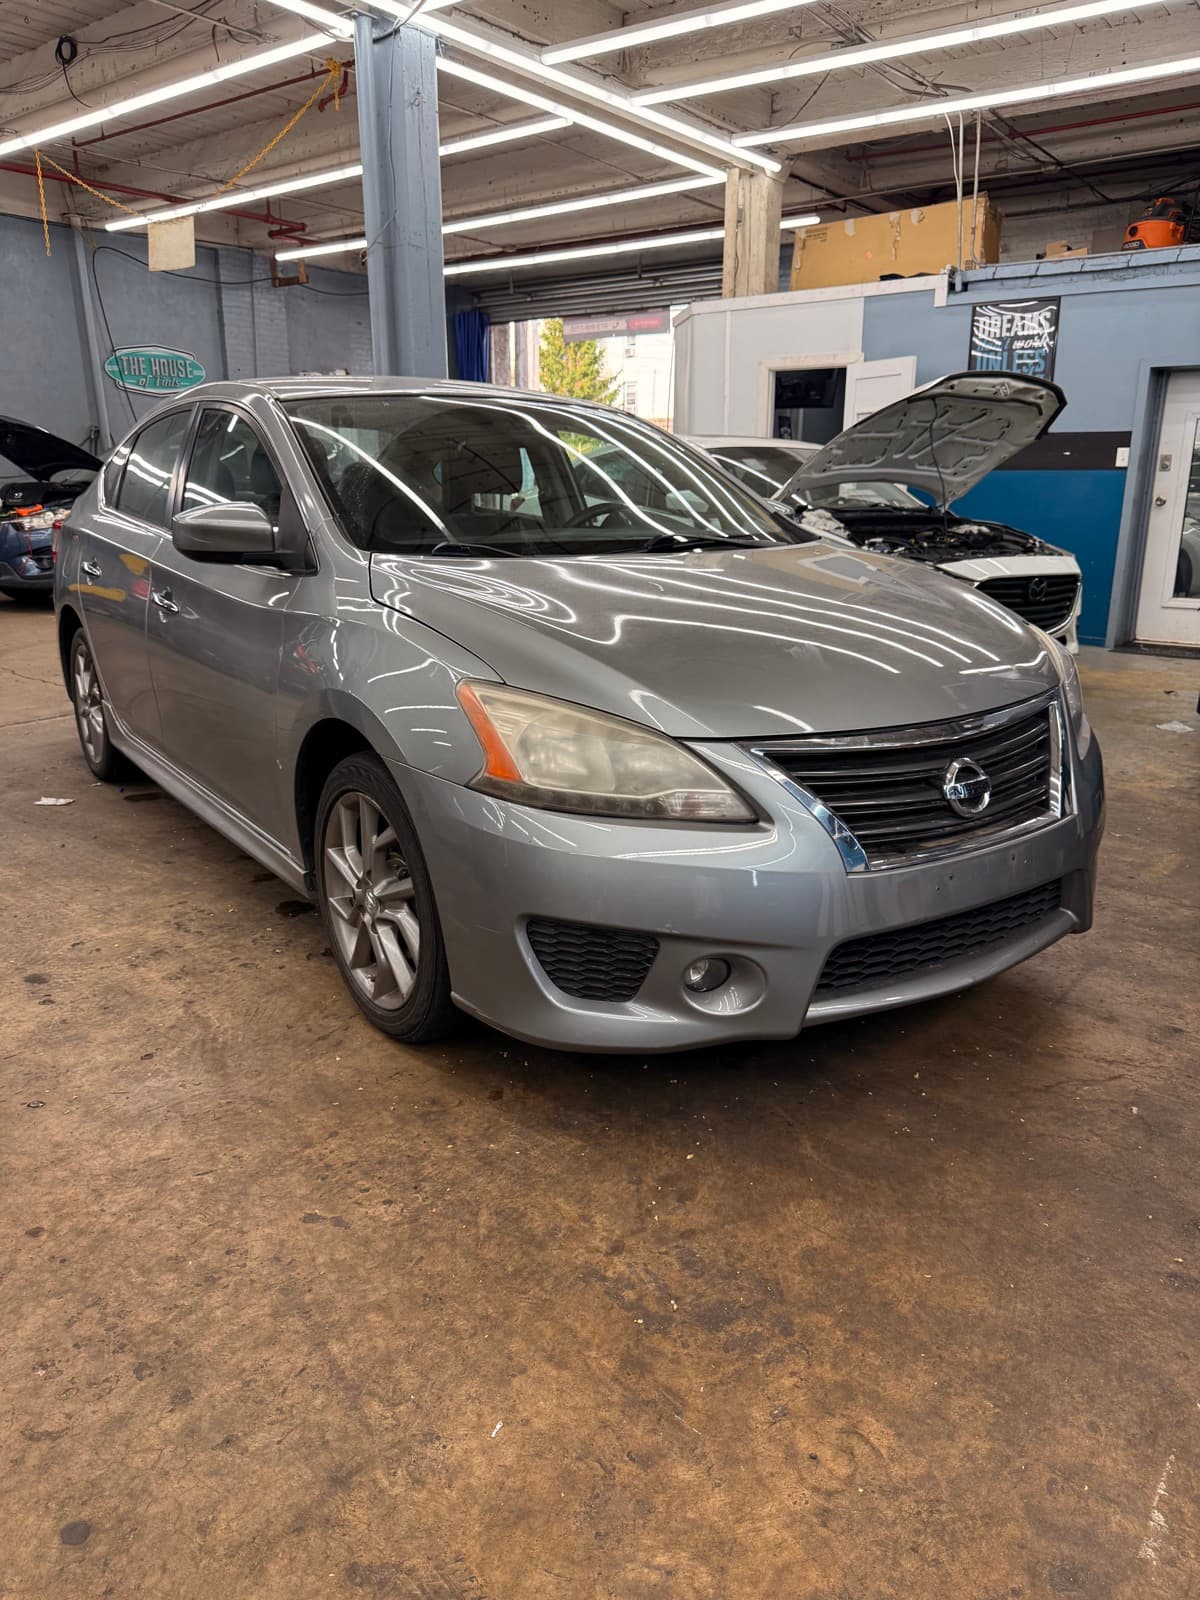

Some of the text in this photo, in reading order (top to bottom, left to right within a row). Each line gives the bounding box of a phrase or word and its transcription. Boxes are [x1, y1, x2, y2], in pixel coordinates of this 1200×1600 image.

[121, 356, 193, 379] THE HOUSE
[138, 374, 153, 389] of
